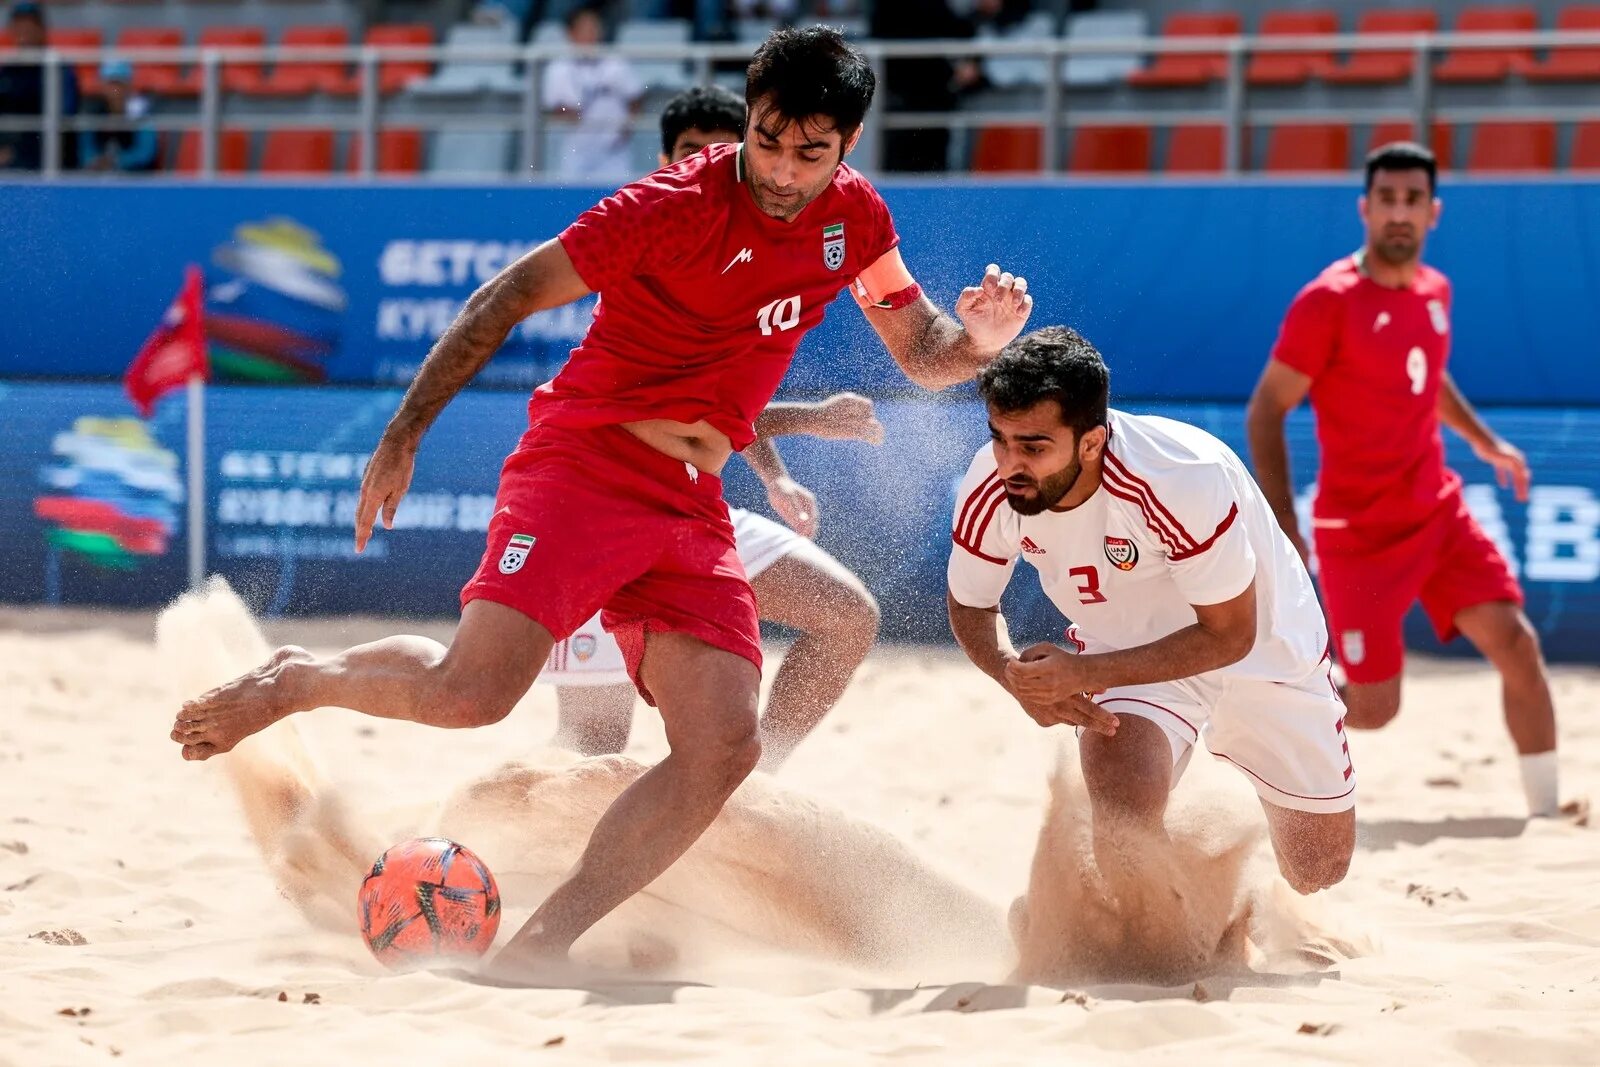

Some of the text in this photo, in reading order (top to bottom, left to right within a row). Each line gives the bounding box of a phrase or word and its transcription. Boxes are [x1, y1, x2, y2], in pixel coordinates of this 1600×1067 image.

[756, 294, 802, 336] 10
[1405, 346, 1428, 396] 9
[1069, 565, 1108, 606] 3
